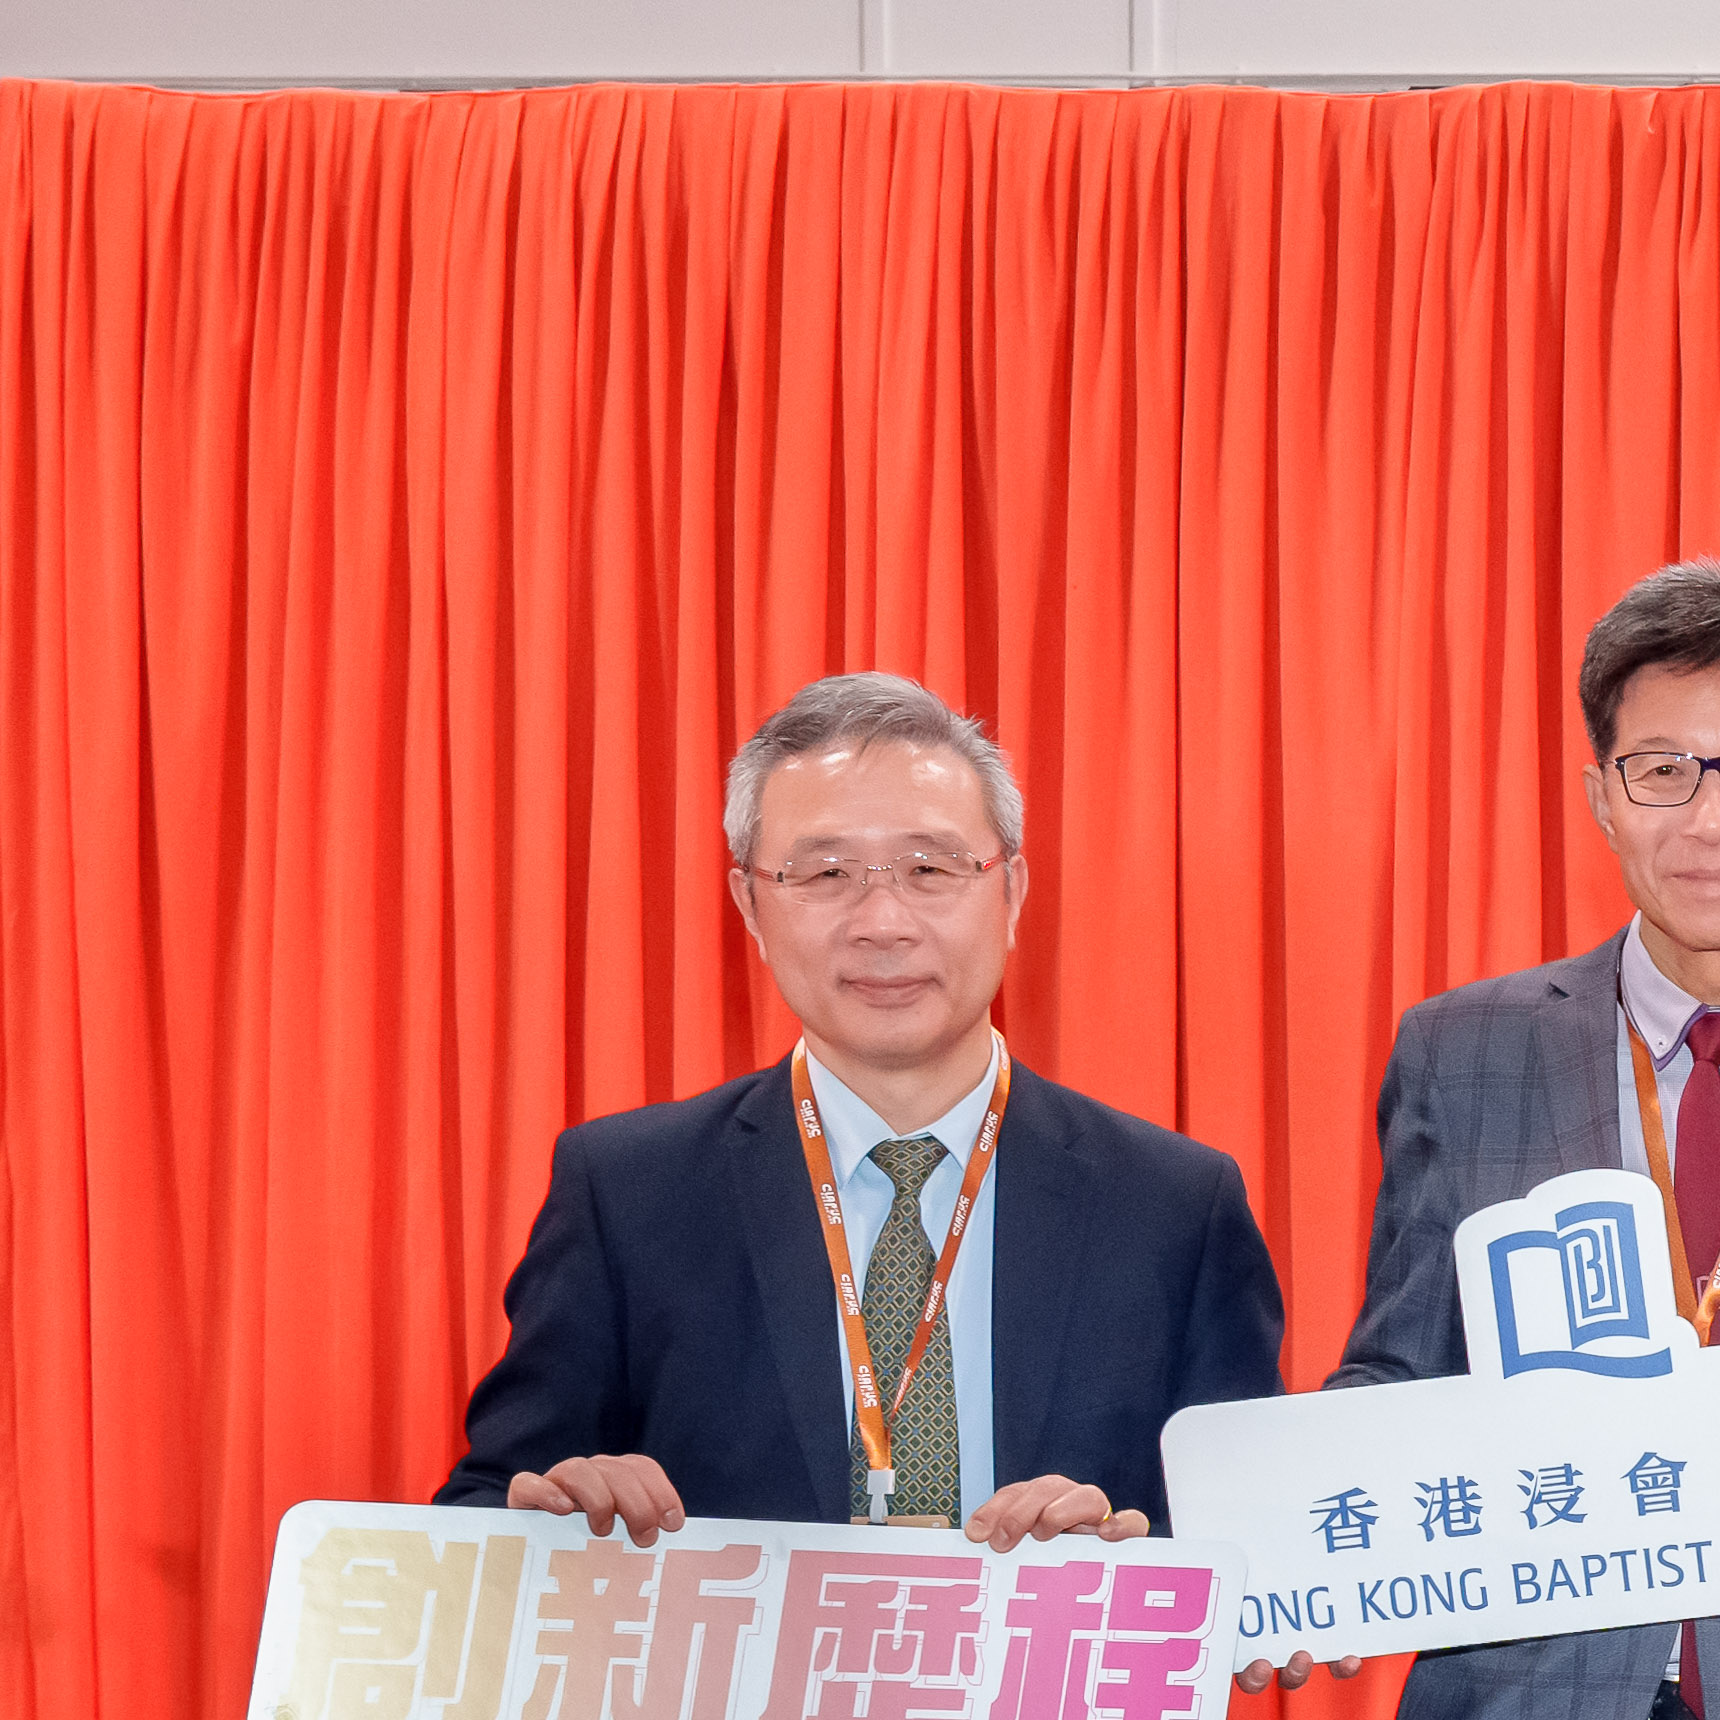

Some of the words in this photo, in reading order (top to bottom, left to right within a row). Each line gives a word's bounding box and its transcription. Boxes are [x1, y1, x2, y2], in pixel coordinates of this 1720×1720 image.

[1240, 1587, 1336, 1638] ONG
[1358, 1568, 1490, 1624] KONG
[1512, 1540, 1712, 1606] BAPTIST
